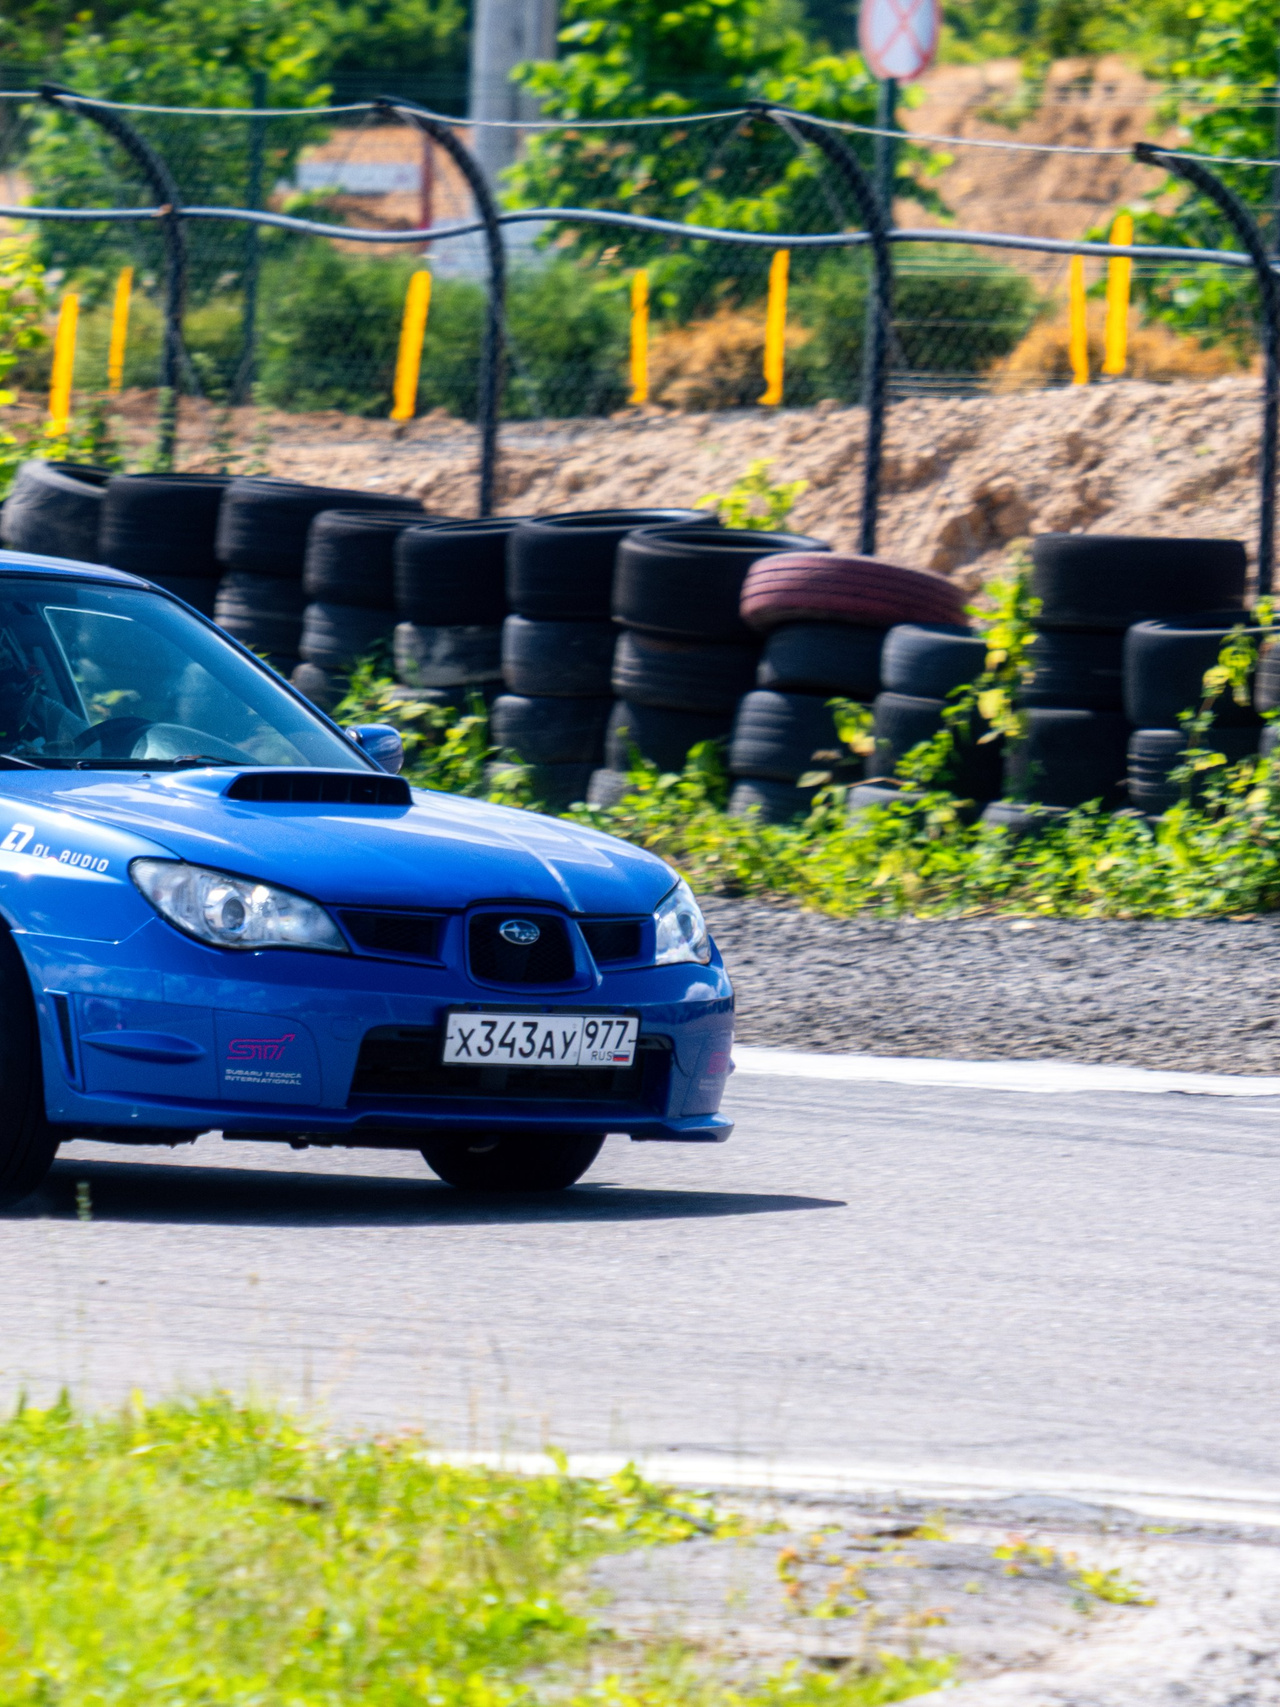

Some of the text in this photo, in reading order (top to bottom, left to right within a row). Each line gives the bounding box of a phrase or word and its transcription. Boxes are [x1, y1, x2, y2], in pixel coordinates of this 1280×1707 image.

[32, 843, 50, 858] DL
[59, 849, 109, 872] AUDIO
[585, 1020, 629, 1050] 977
[591, 1051, 612, 1061] RUS
[225, 1068, 302, 1079] SUBARU TECNICA
[224, 1074, 302, 1086] INTERNATIONAL
